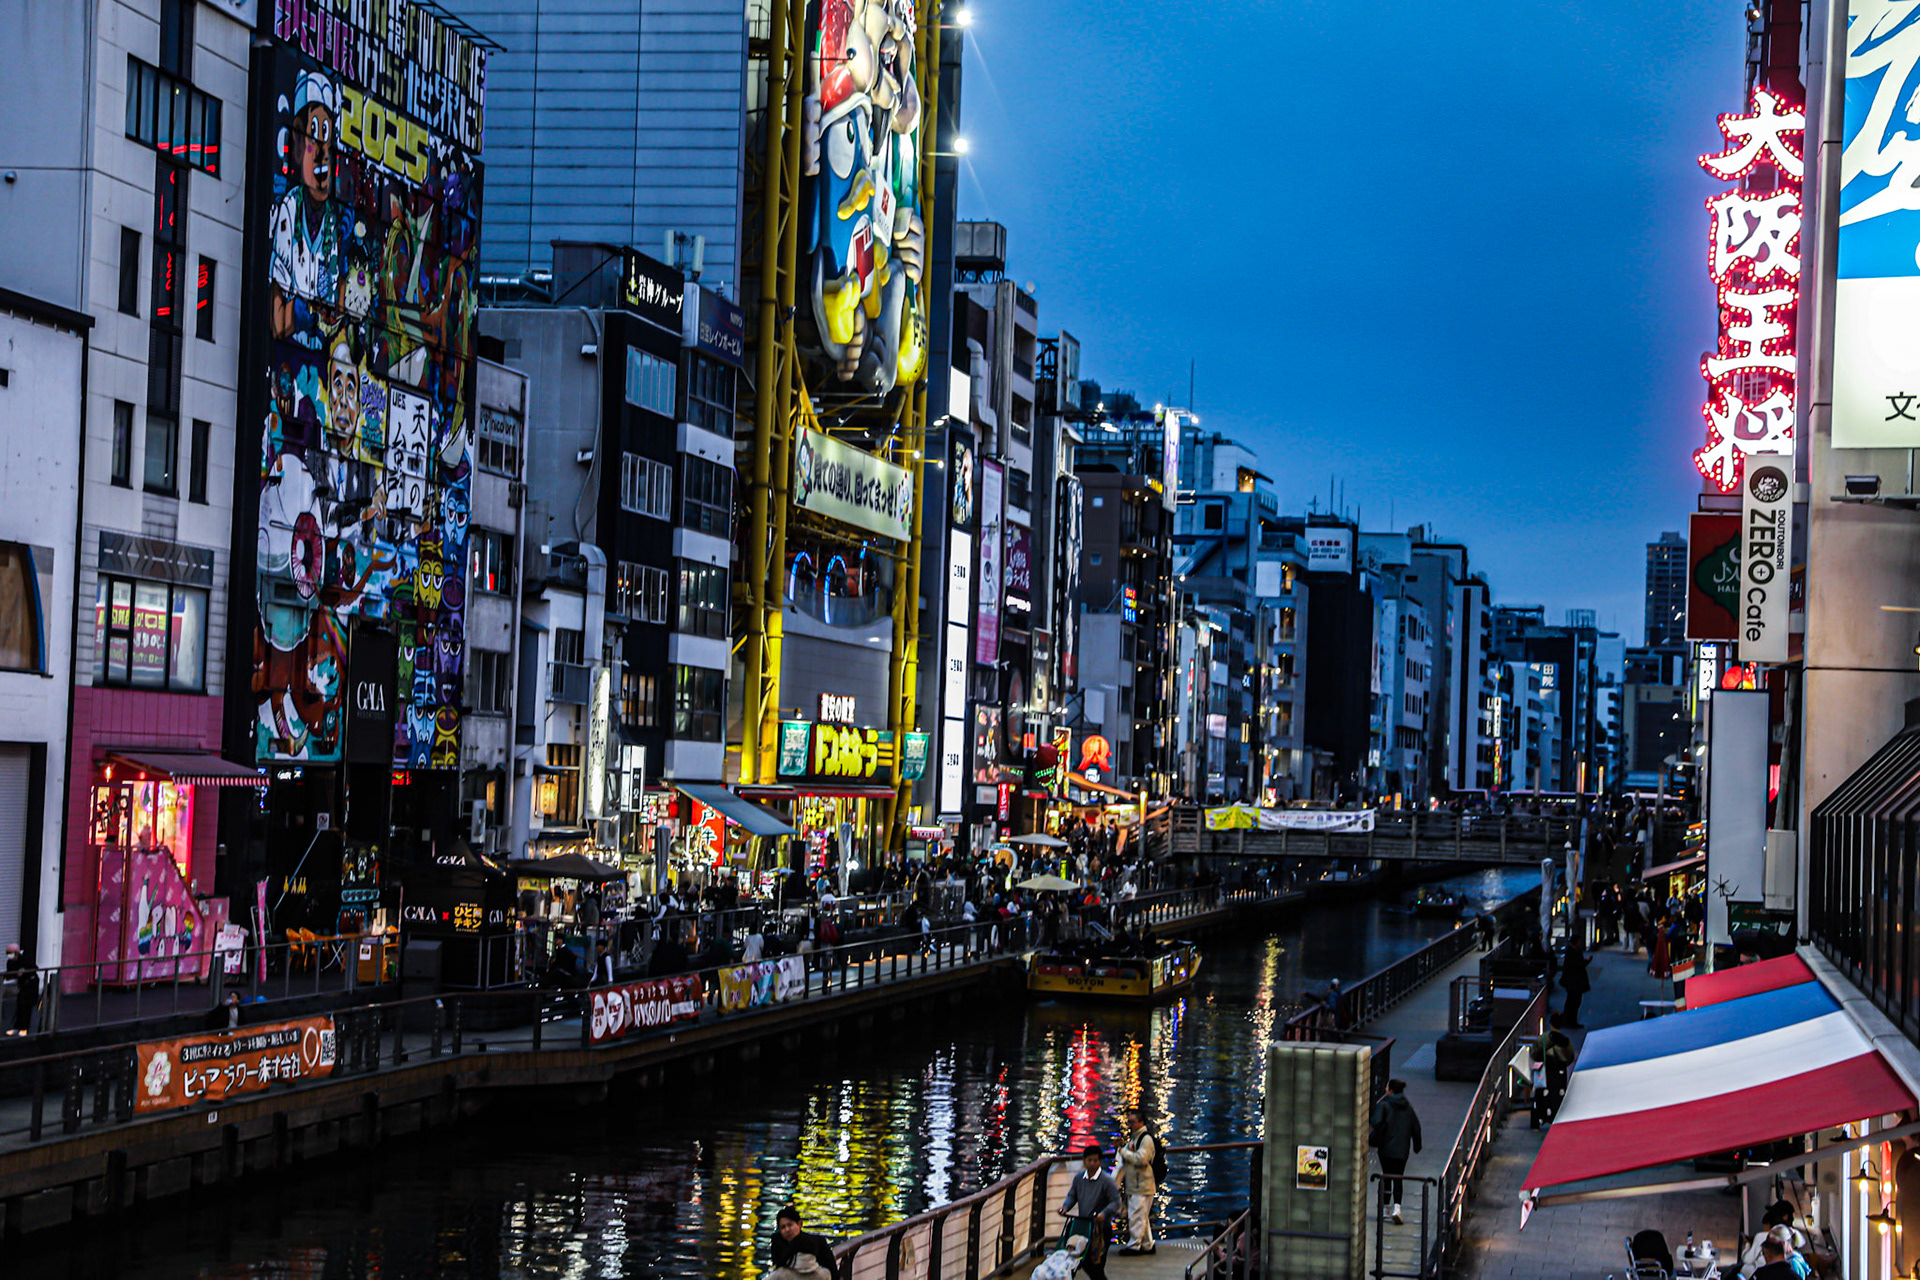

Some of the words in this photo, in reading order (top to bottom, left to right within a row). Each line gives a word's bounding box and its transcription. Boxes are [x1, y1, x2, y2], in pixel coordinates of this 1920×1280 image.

[340, 84, 431, 187] 2025
[1696, 86, 1806, 492] 大阪王将
[1884, 390, 1920, 422] 文
[1748, 508, 1777, 585] ZERO
[1745, 587, 1767, 642] cafe
